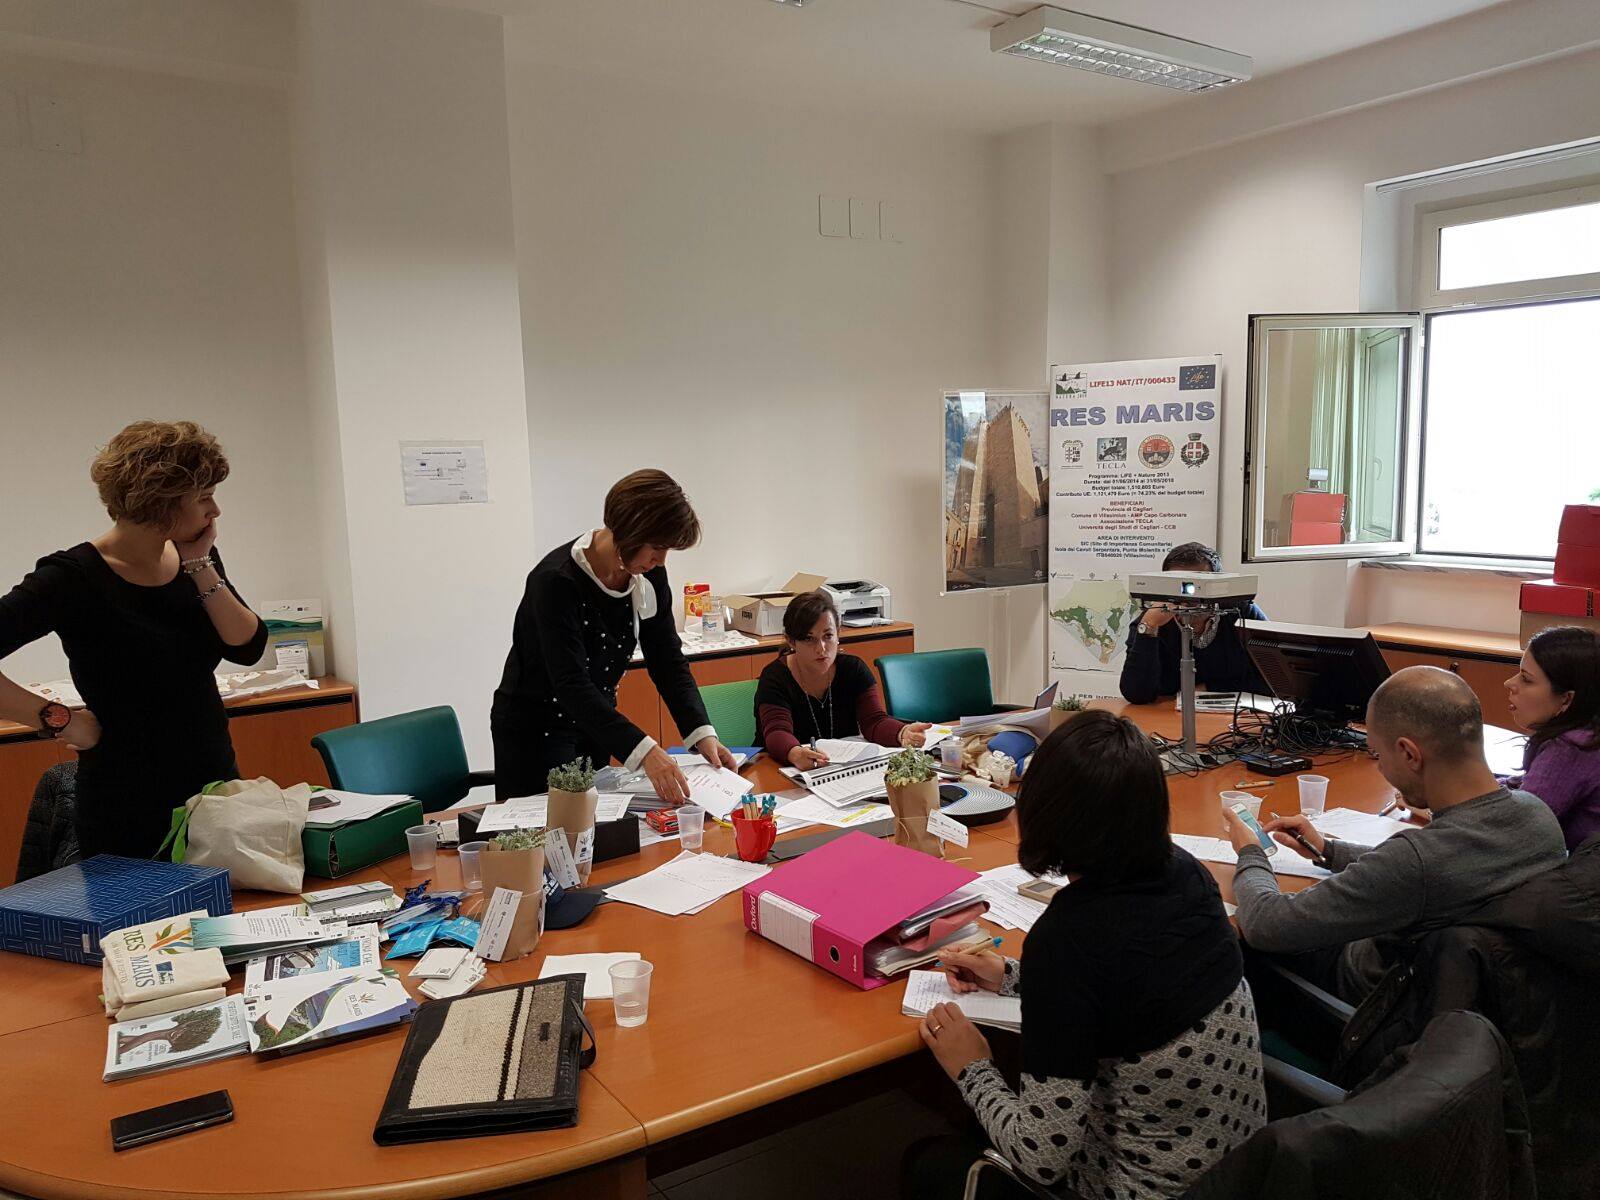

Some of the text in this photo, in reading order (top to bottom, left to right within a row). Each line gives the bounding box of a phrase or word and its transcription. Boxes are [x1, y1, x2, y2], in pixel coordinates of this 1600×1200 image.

[1116, 376, 1176, 387] NAT/IT/000433
[1051, 402, 1215, 426] RES MARIS
[123, 929, 155, 988] RES MARIS
